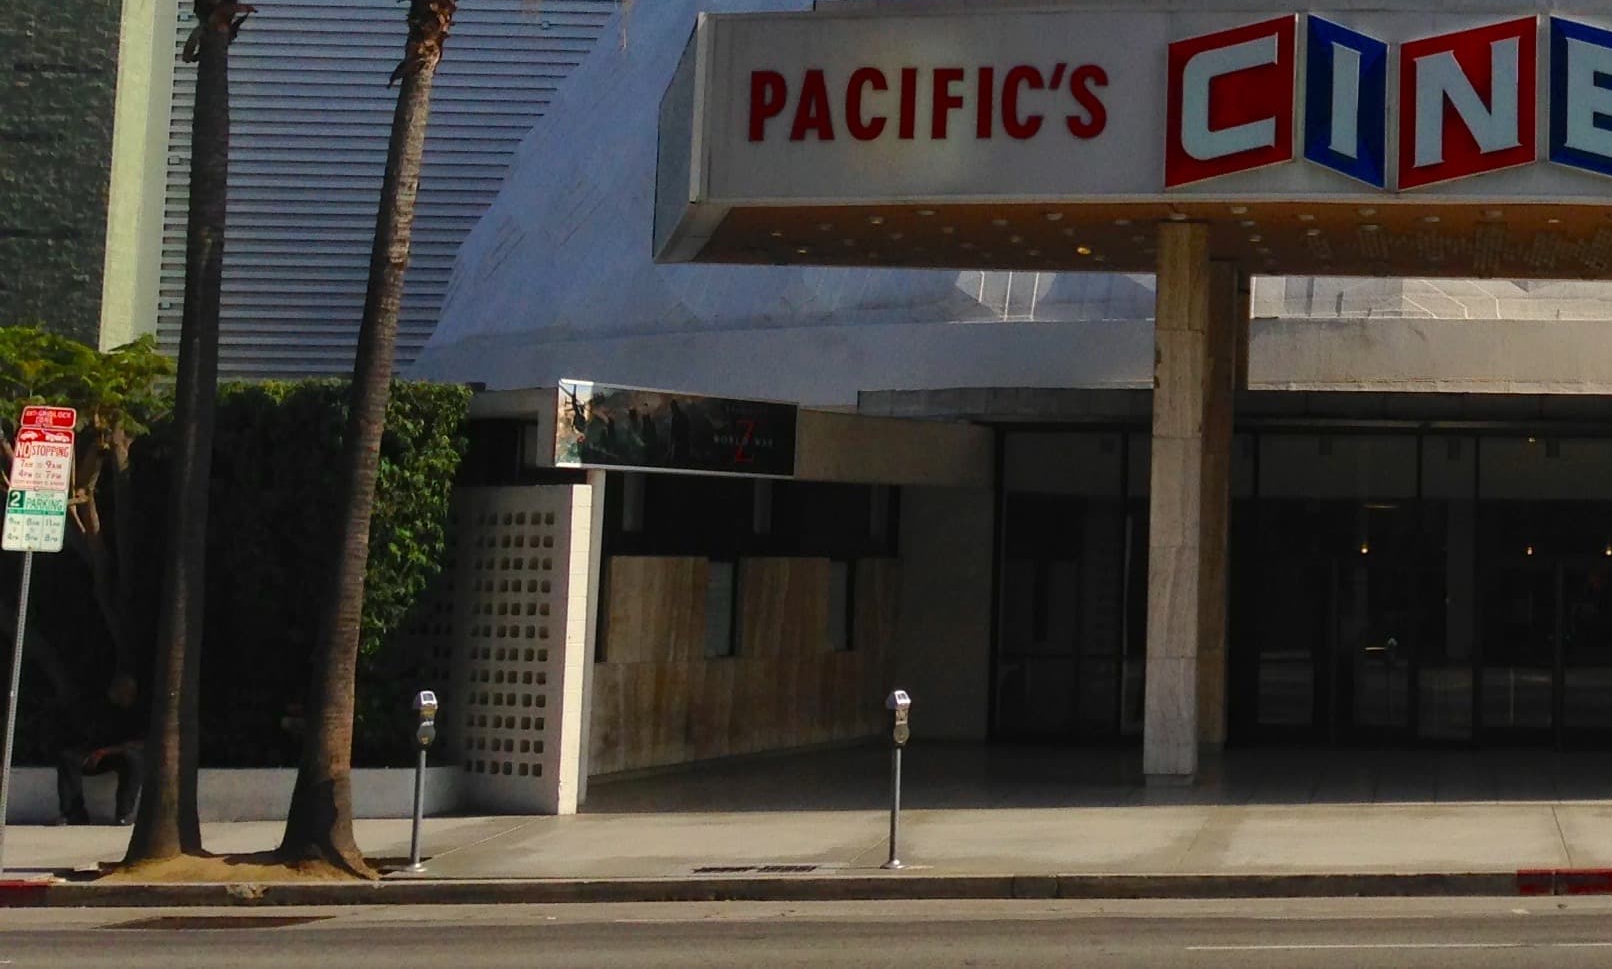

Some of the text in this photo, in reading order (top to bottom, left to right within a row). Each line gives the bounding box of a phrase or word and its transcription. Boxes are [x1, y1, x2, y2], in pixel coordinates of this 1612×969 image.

[748, 62, 1109, 142] PACIFIC'S
[15, 442, 69, 458] NO STOPPING
[10, 491, 21, 507] 2
[26, 497, 63, 511] PARKING
